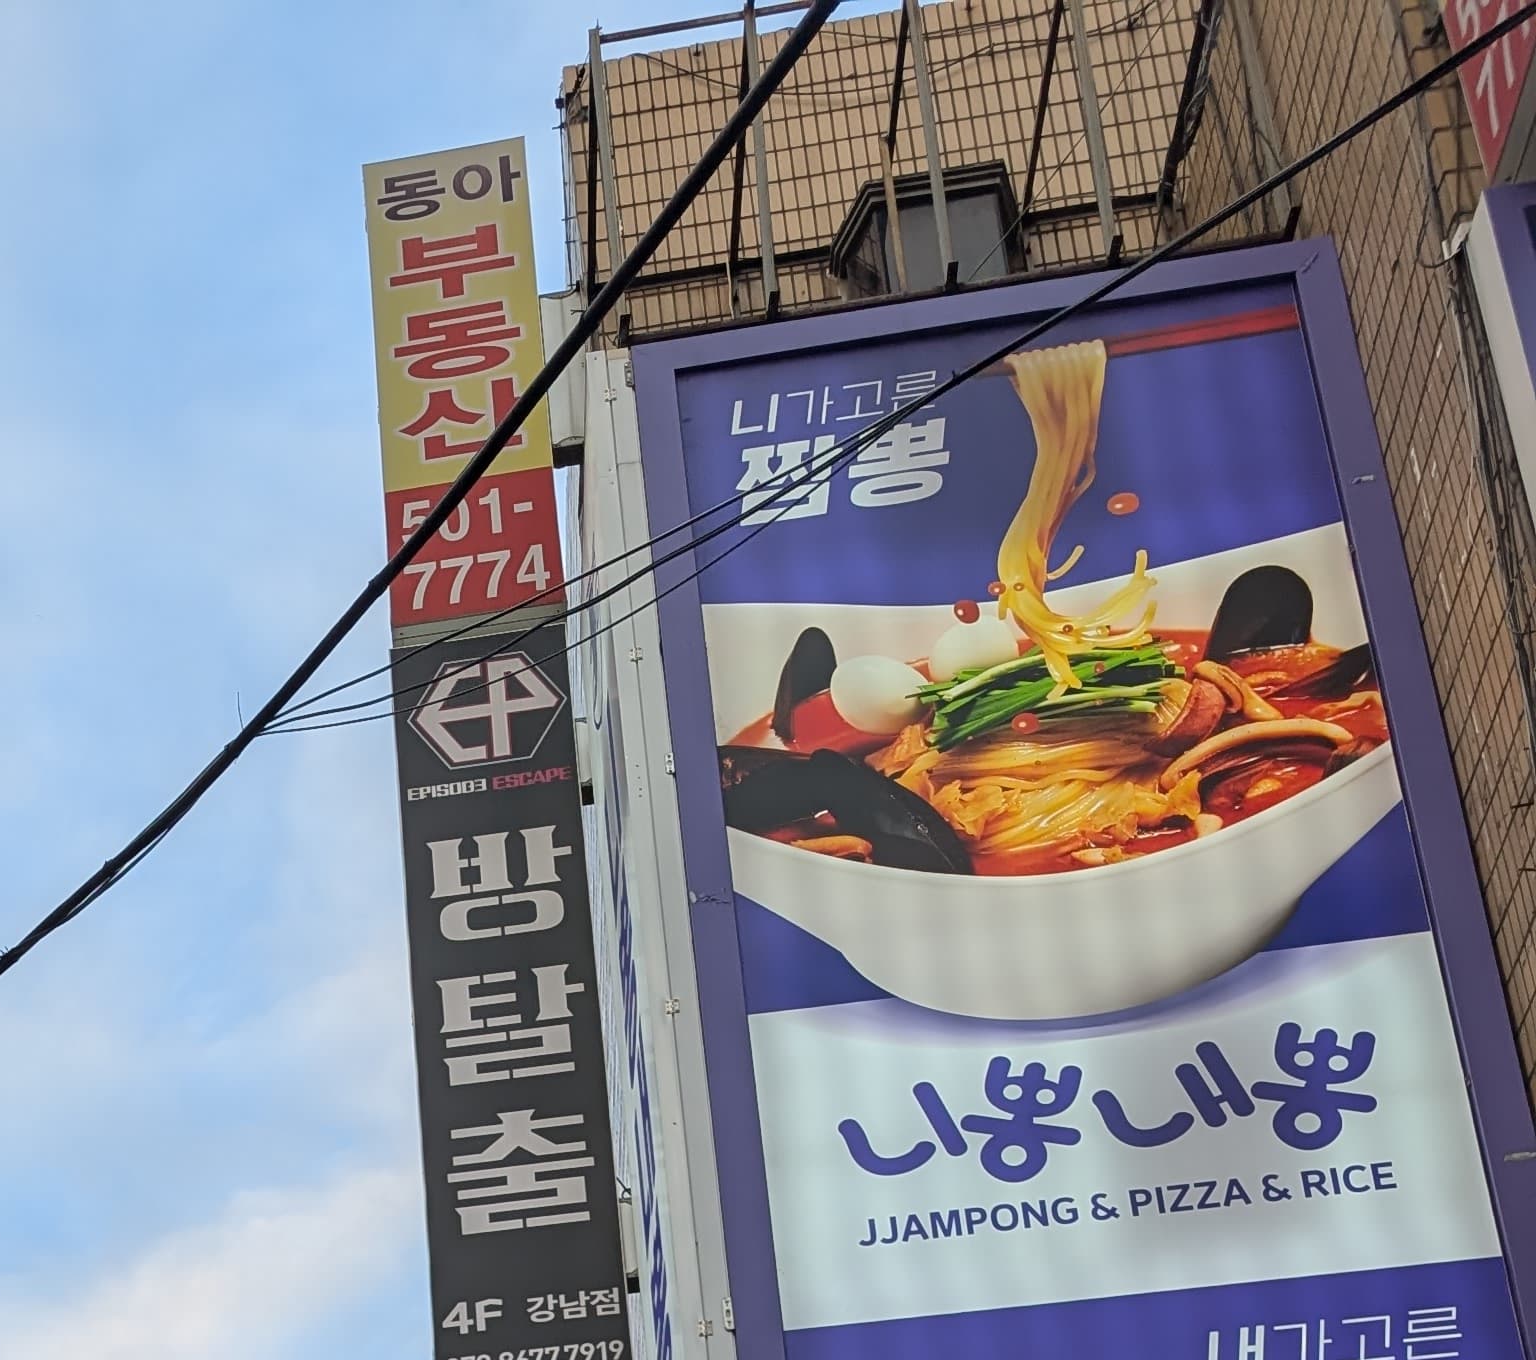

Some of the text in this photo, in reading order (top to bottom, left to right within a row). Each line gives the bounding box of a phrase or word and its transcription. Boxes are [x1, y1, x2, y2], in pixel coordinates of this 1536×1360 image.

[377, 154, 521, 221] 동아
[388, 222, 523, 462] 부동산
[730, 368, 938, 437] 니가고른
[735, 416, 951, 527] 짬뽕
[402, 543, 551, 611] 7774
[491, 766, 572, 790] ESCAPE
[426, 825, 595, 1236] 방탈출
[837, 1021, 1378, 1184] 니뽕내뽕
[858, 1160, 1398, 1248] JJAMPONG & PIZZA & RICE
[441, 1286, 622, 1335] 4F 강남점
